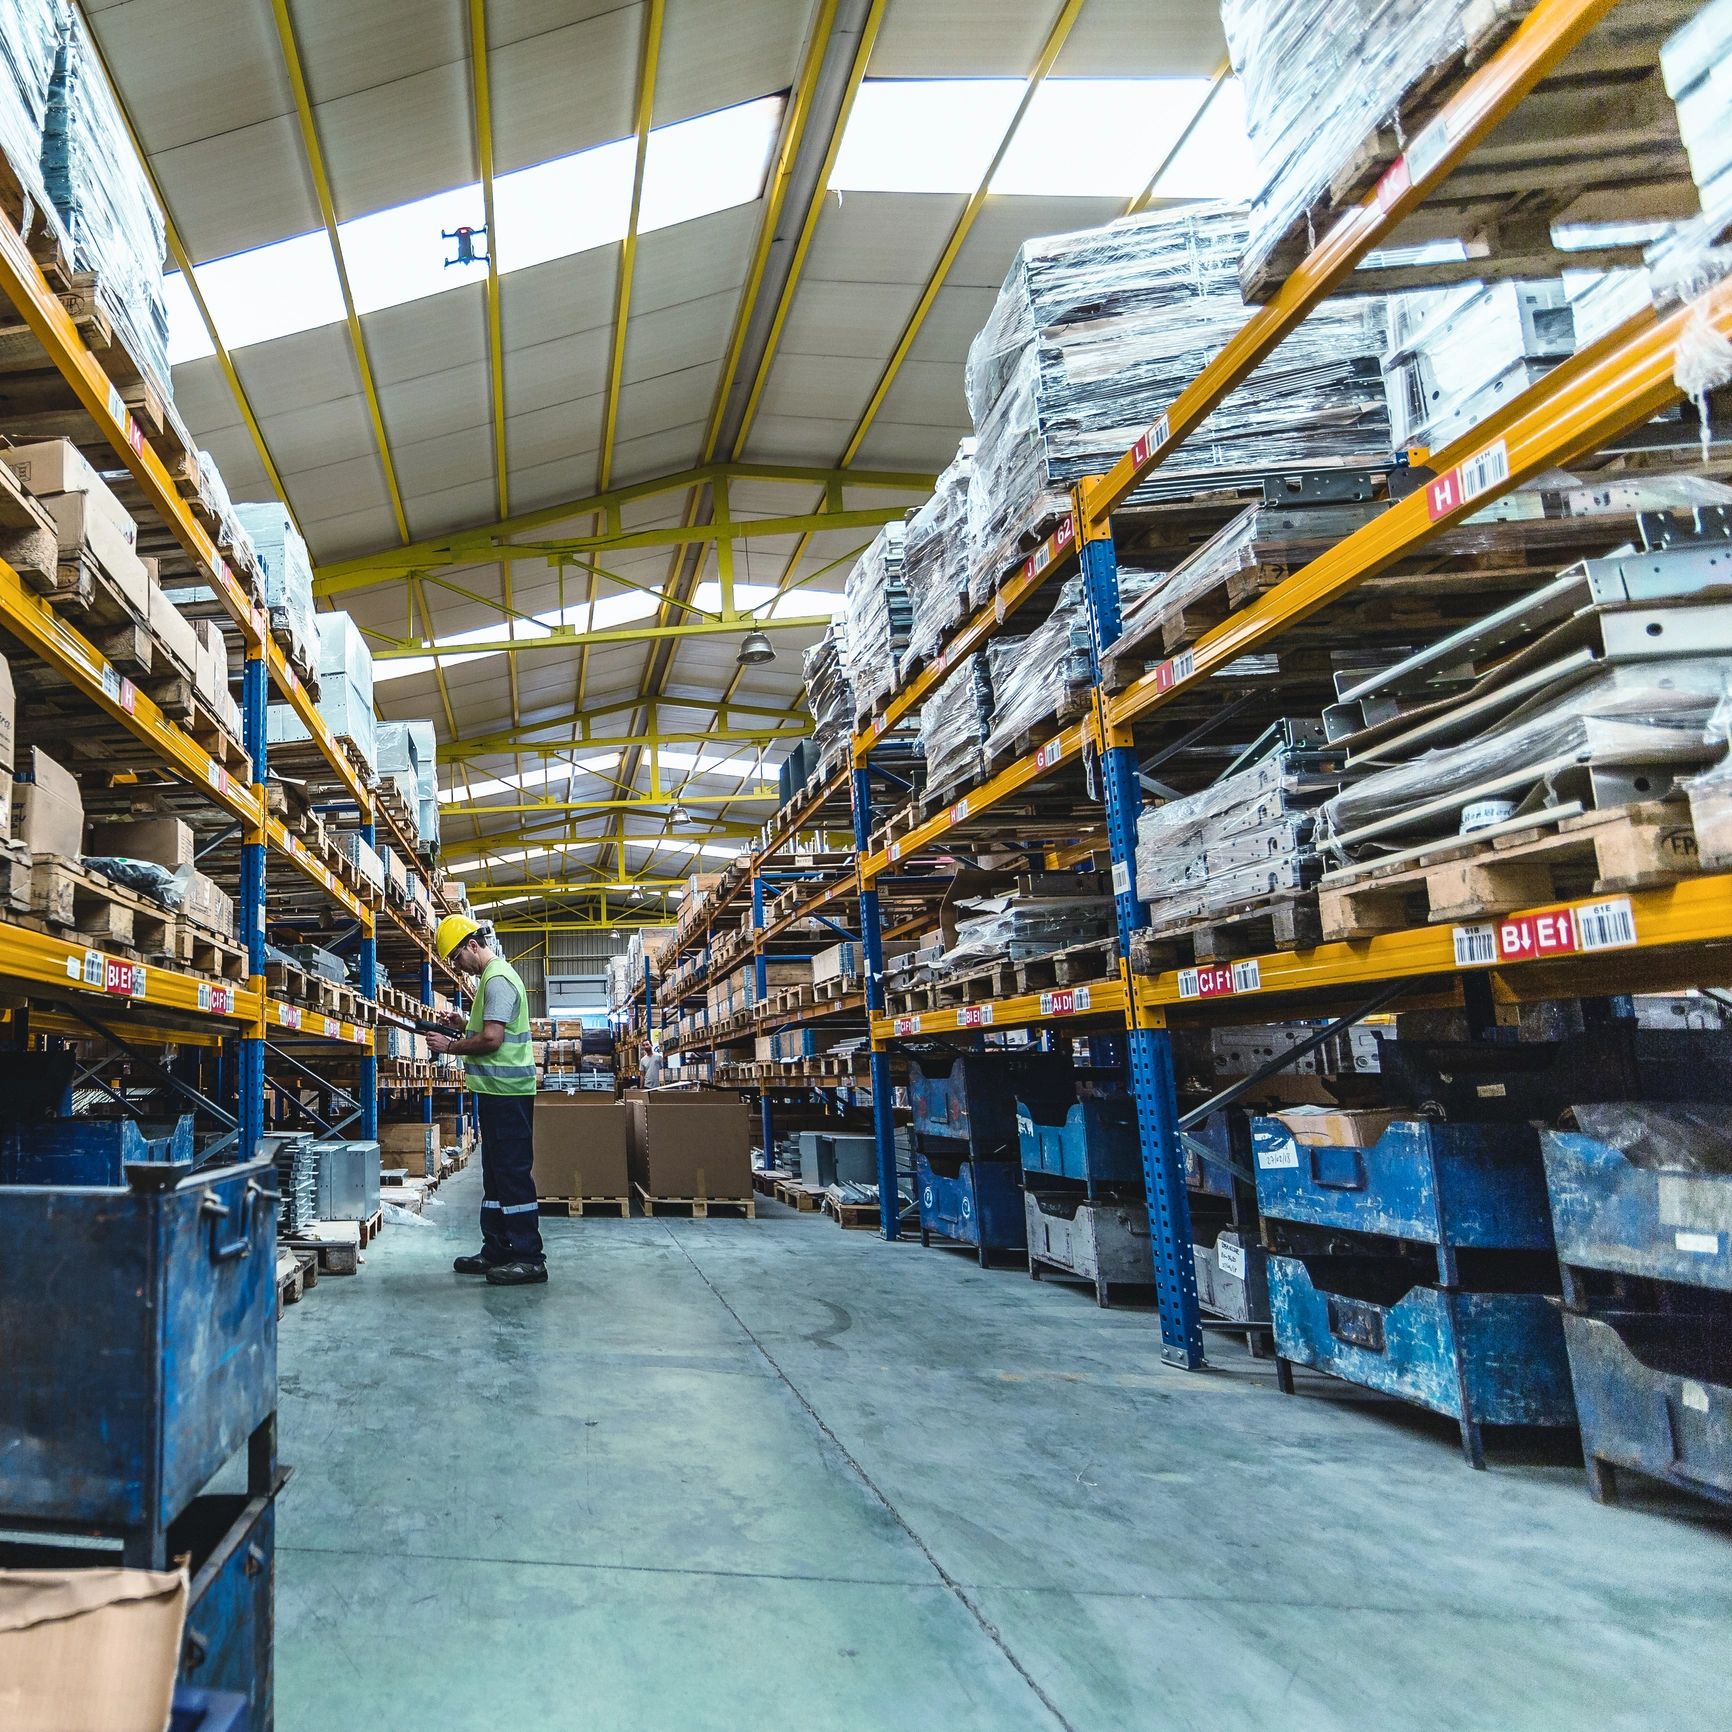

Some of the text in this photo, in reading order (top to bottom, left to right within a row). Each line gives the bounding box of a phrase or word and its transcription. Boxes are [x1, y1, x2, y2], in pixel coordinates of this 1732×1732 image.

[133, 424, 142, 449] K
[1135, 446, 1144, 463] L
[1434, 479, 1453, 512] H
[1027, 518, 1072, 577] J 62
[125, 684, 133, 707] H
[1037, 752, 1044, 767] G
[950, 809, 956, 822] H
[1465, 904, 1612, 953] 61B B E 61E
[108, 965, 128, 988] B E
[1200, 973, 1210, 992] C
[1216, 970, 1224, 990] F
[212, 991, 224, 1009] C F
[1053, 995, 1069, 1012] A D
[966, 1008, 980, 1023] B E
